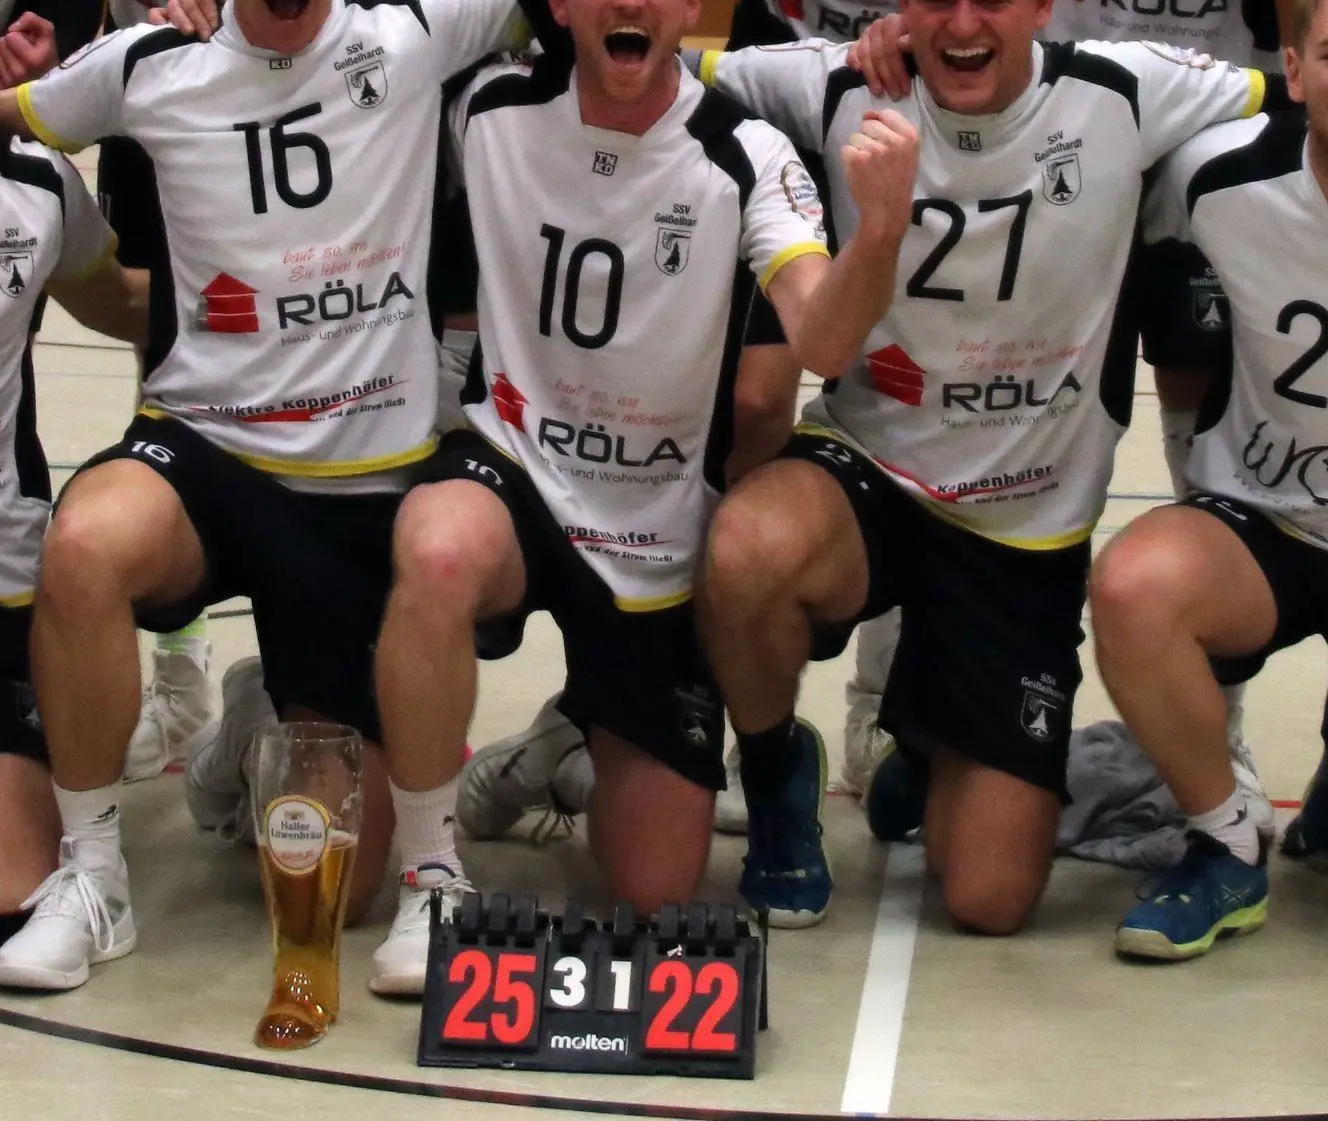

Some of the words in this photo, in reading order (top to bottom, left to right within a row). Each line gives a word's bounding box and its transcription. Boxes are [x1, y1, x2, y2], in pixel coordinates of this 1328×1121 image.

[334, 46, 385, 71] Geißelhardt
[346, 42, 364, 54] SSV
[1048, 130, 1064, 145] SSV
[233, 102, 333, 214] 16
[672, 204, 692, 214] SSV
[5, 228, 19, 238] SSV
[907, 189, 1033, 301] 27
[540, 223, 624, 349] 10
[276, 271, 414, 329] RÖLA
[281, 333, 314, 346] Haus-
[319, 329, 342, 341] und
[282, 374, 395, 410] Koppenhöfer
[943, 370, 1082, 413] RÖLA
[980, 414, 1004, 427] und
[131, 441, 175, 464] 16
[539, 417, 687, 467] RÖLA
[570, 467, 594, 480] und
[599, 471, 689, 486] Wohnungsbau
[271, 828, 322, 839] Löwenbräu
[281, 821, 310, 830] Haller
[442, 949, 538, 1044] 25
[550, 956, 587, 1007] 3
[610, 960, 633, 1010] 1
[644, 960, 740, 1052] 22
[551, 1033, 625, 1052] molten
